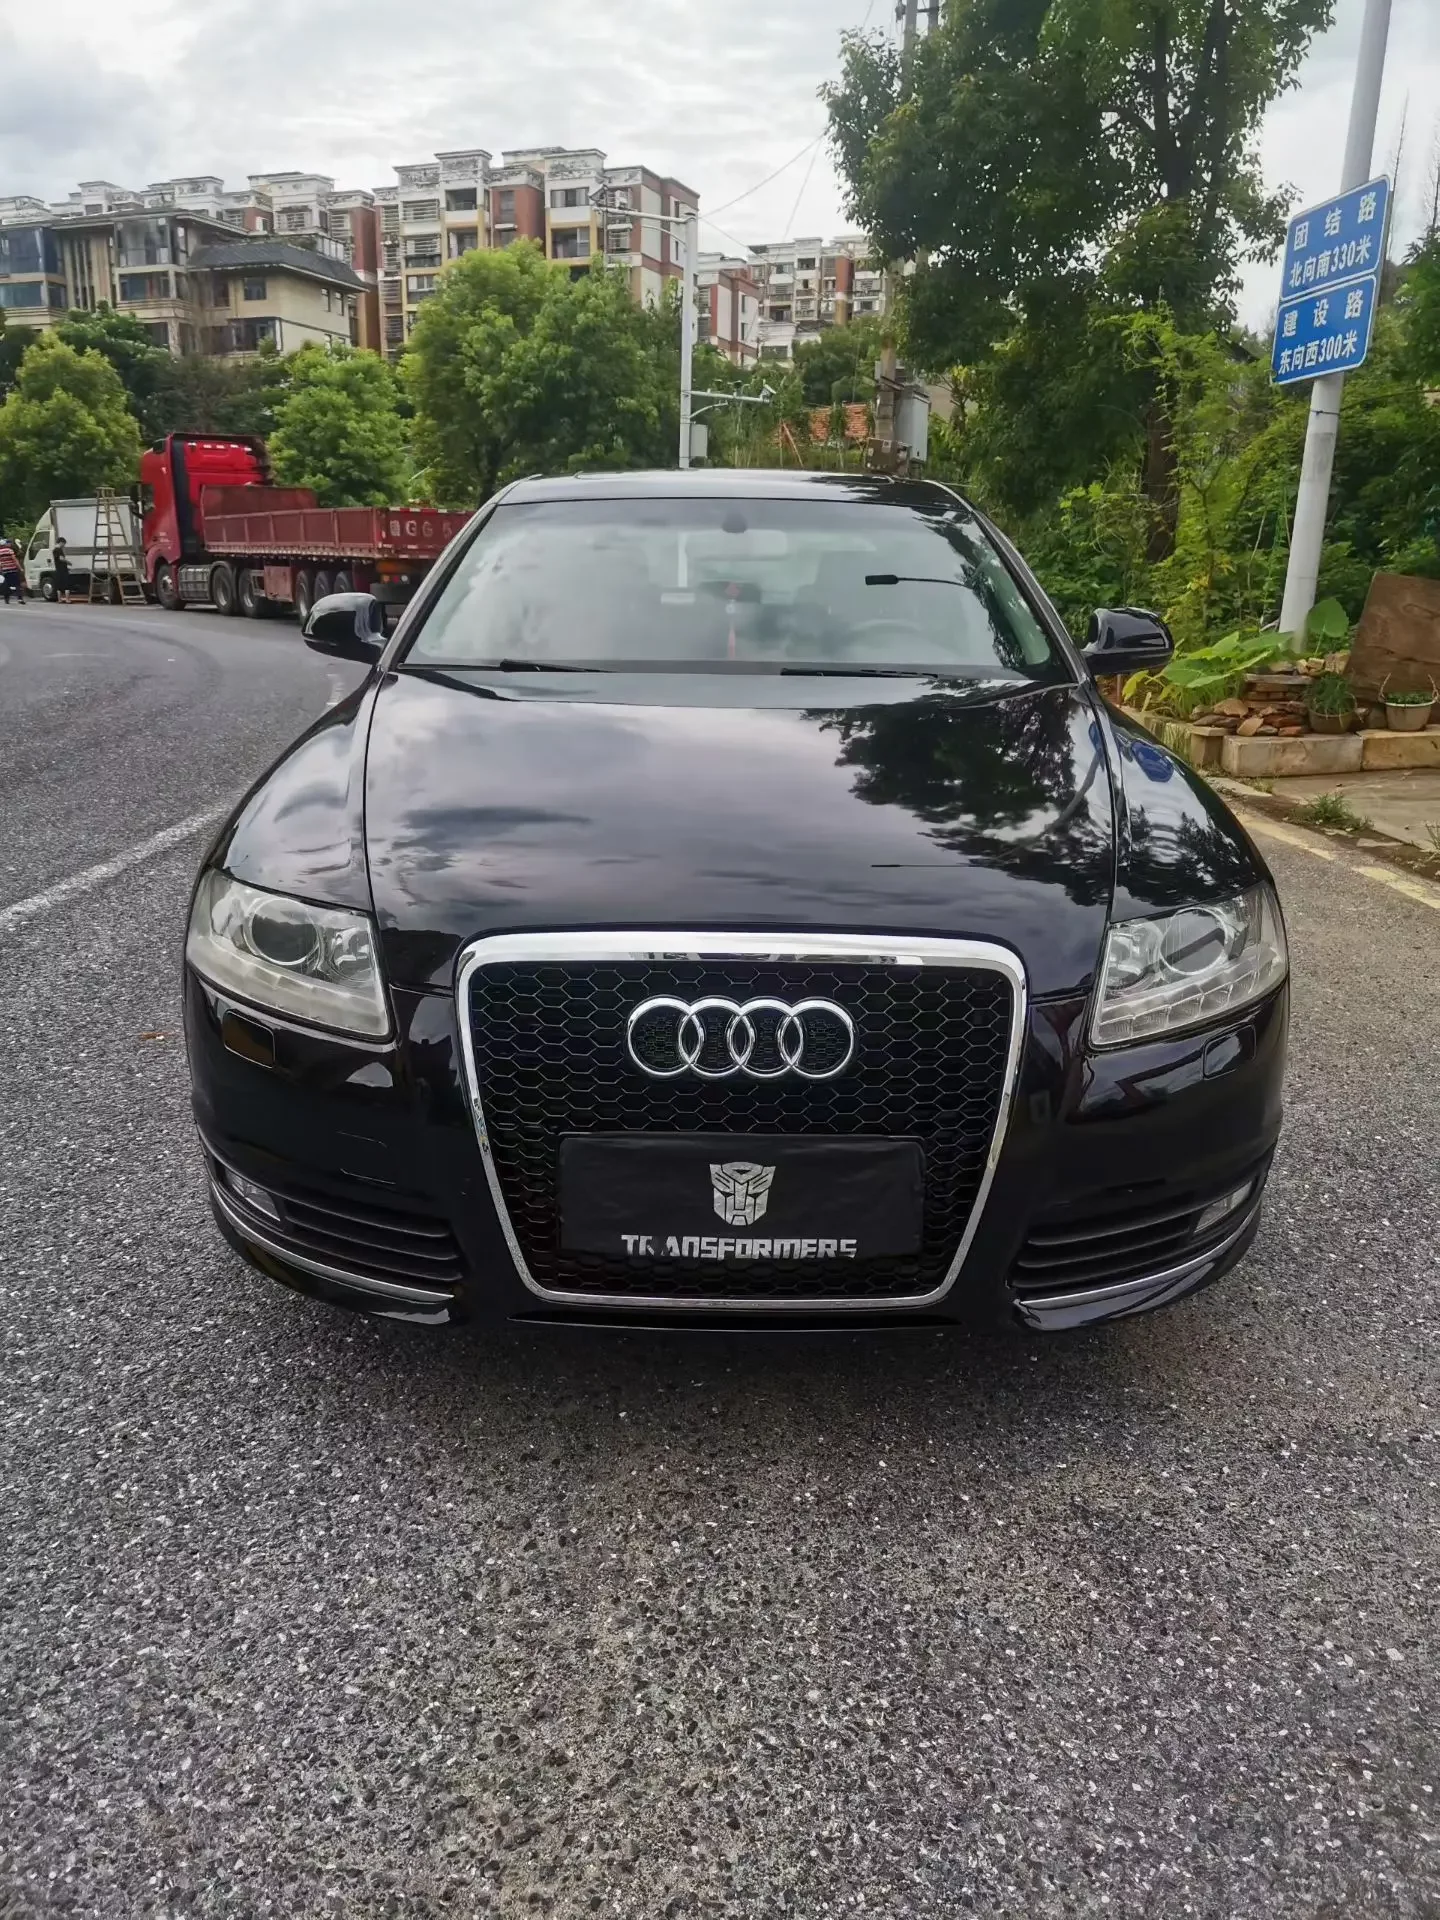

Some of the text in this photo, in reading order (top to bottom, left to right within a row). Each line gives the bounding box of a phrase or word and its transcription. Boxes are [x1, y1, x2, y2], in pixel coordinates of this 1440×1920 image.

[1293, 192, 1376, 251] 团结路
[1288, 235, 1372, 288] 北向南330米
[1282, 289, 1363, 338] 建设路
[1278, 330, 1357, 374] 东向西300米
[620, 1234, 858, 1260] TRANSFORMERS
